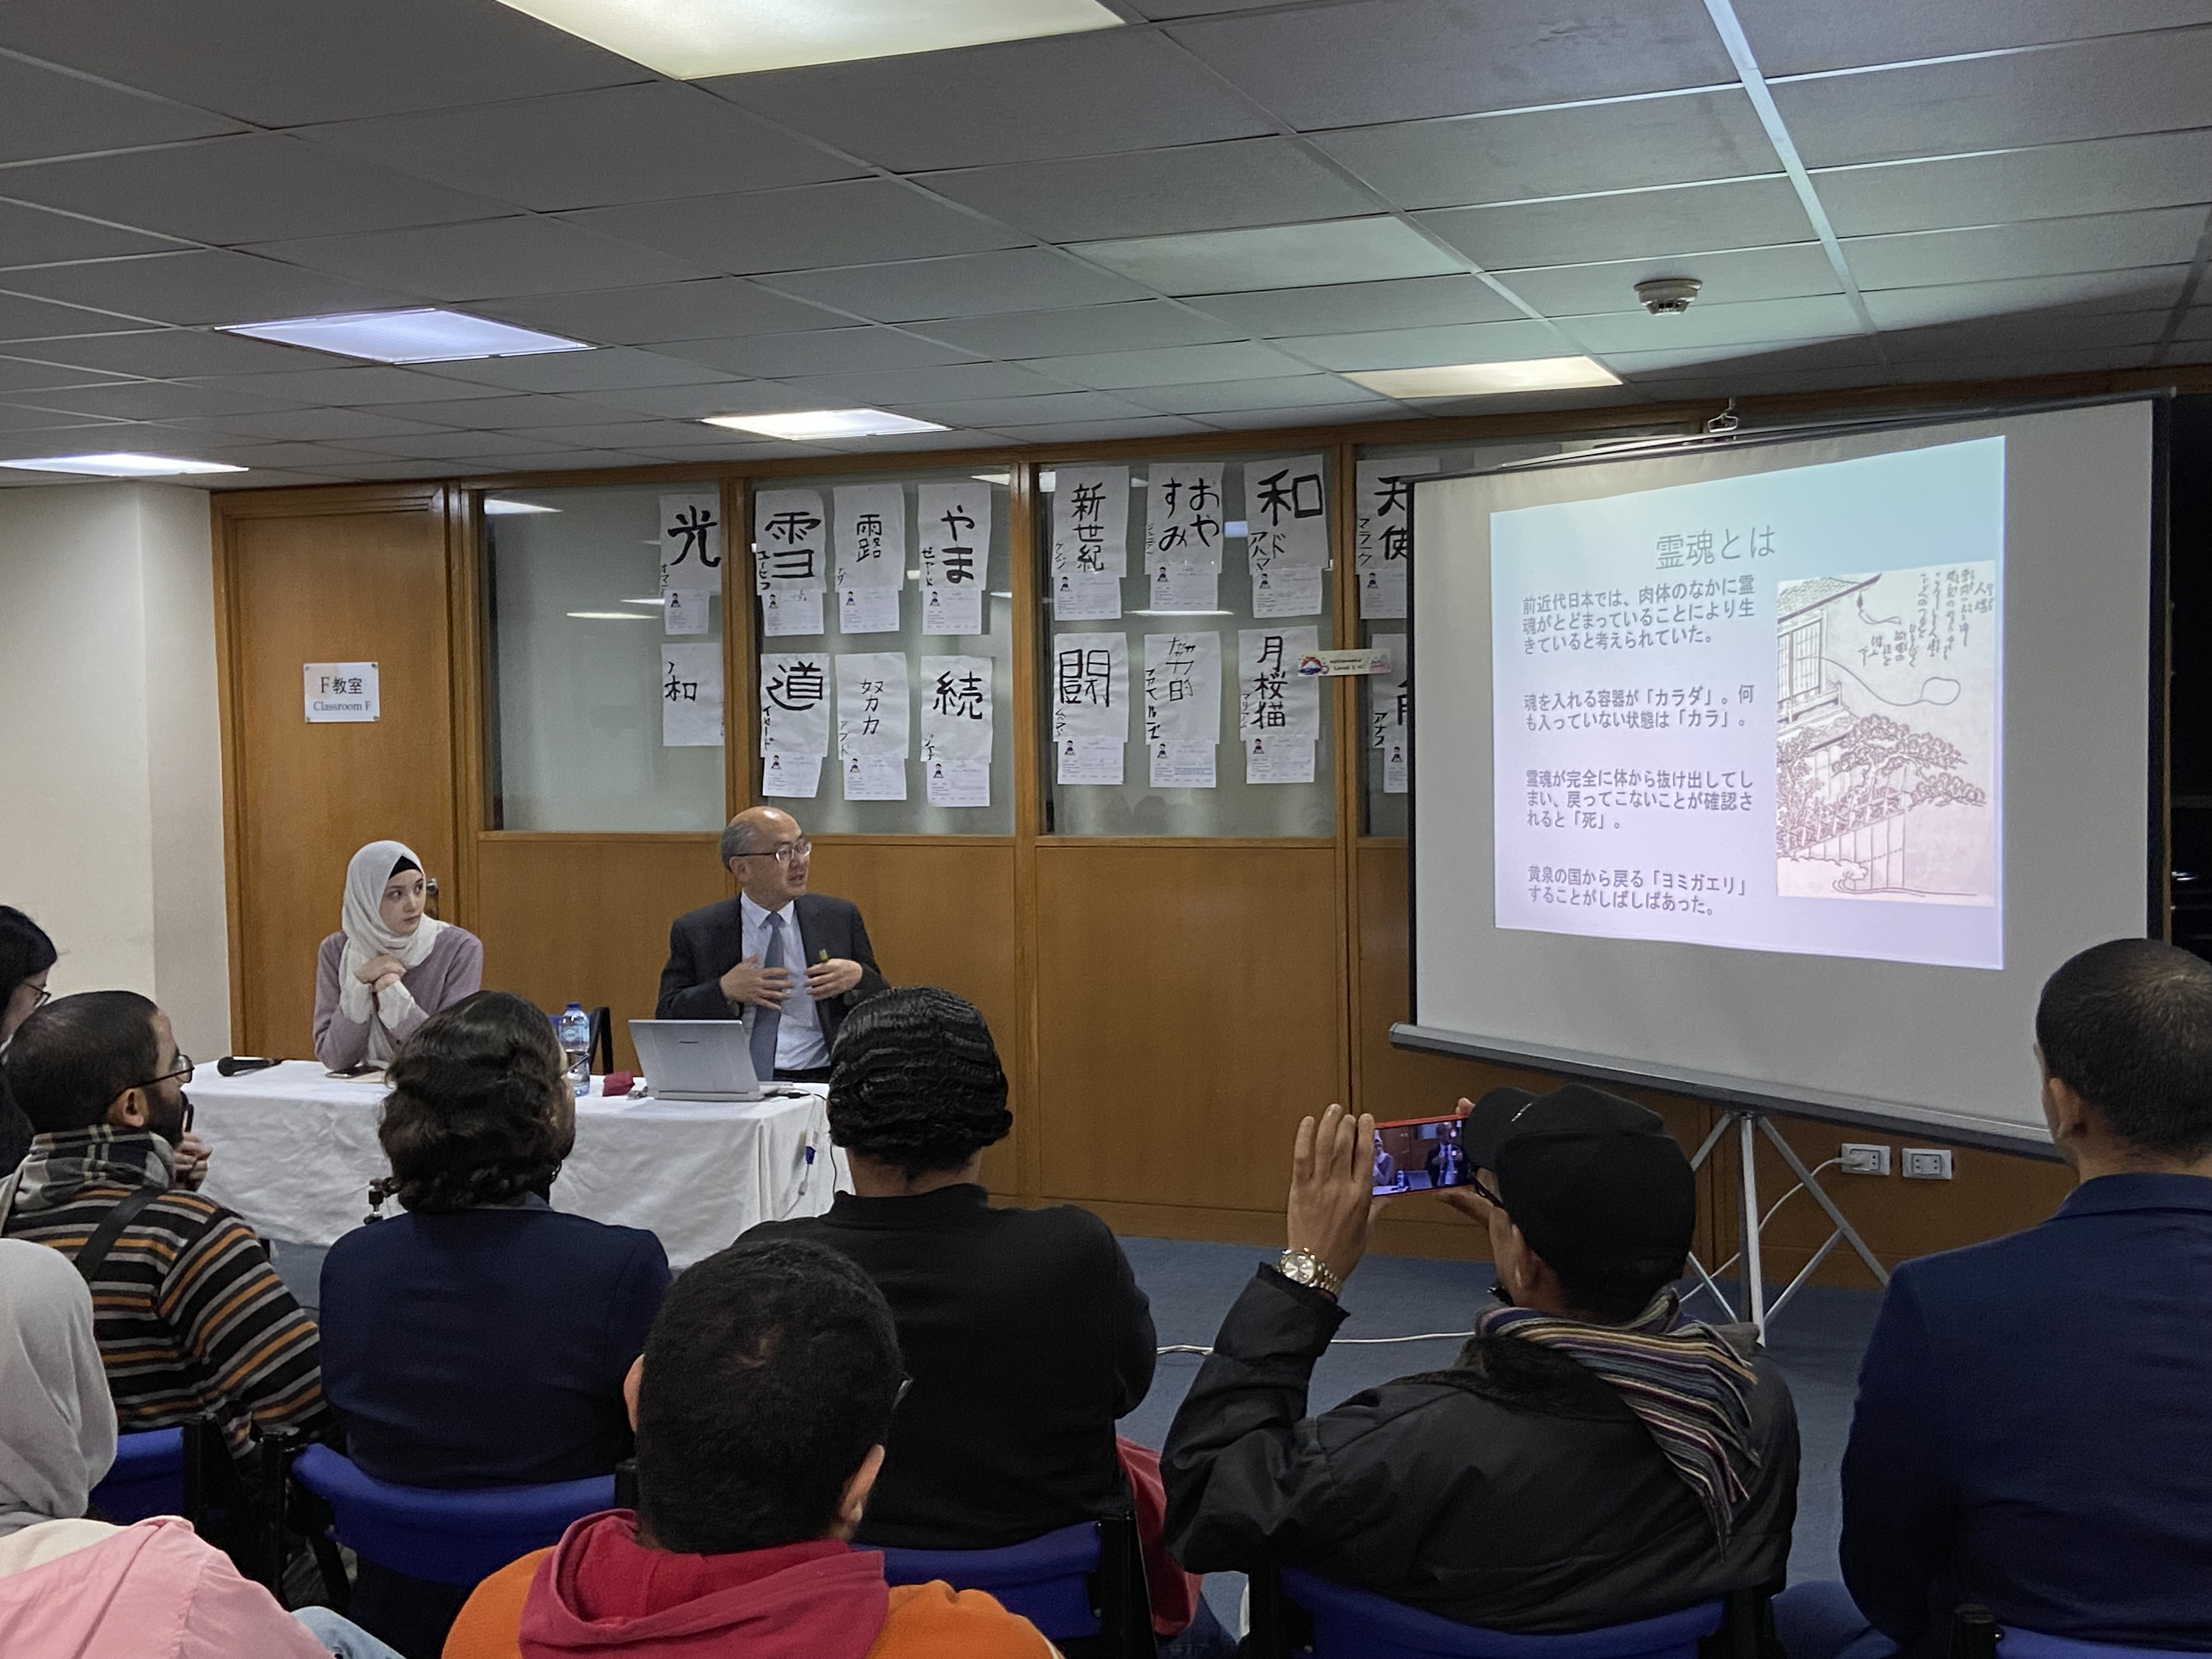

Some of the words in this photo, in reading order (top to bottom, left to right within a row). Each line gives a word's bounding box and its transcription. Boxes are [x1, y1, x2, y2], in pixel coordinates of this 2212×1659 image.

[1257, 469, 1323, 526] 和
[668, 505, 721, 567] 光
[765, 511, 821, 579] 雪
[940, 504, 975, 584] やま
[1071, 482, 1106, 572] 新世紀
[1656, 525, 1776, 569] 霊魂とは
[1522, 575, 1754, 614] 前近代日本では、肉体のなかに霊
[1523, 598, 1754, 635] 魂がとどまっていることにより生
[1525, 625, 1711, 654] きていると考えられていた。
[766, 661, 823, 710] 道
[933, 670, 983, 720] 続
[1524, 684, 1754, 712] 魂を入れる容器が「カラダ」。何
[313, 701, 362, 712] Classroom
[365, 701, 371, 710] F
[1526, 708, 1745, 732] も入っていない状態は「カラ」。
[1526, 770, 1753, 789] 霊魂が完全に体から抜け出してし
[1527, 791, 1753, 811] まい、戻ってこないことが確認さ
[1527, 810, 1620, 829] れると「死」。
[1527, 865, 1746, 896] 黄泉の国から戻る「ヨミガエリ」
[1528, 885, 1713, 915] することがしばしばあった。
